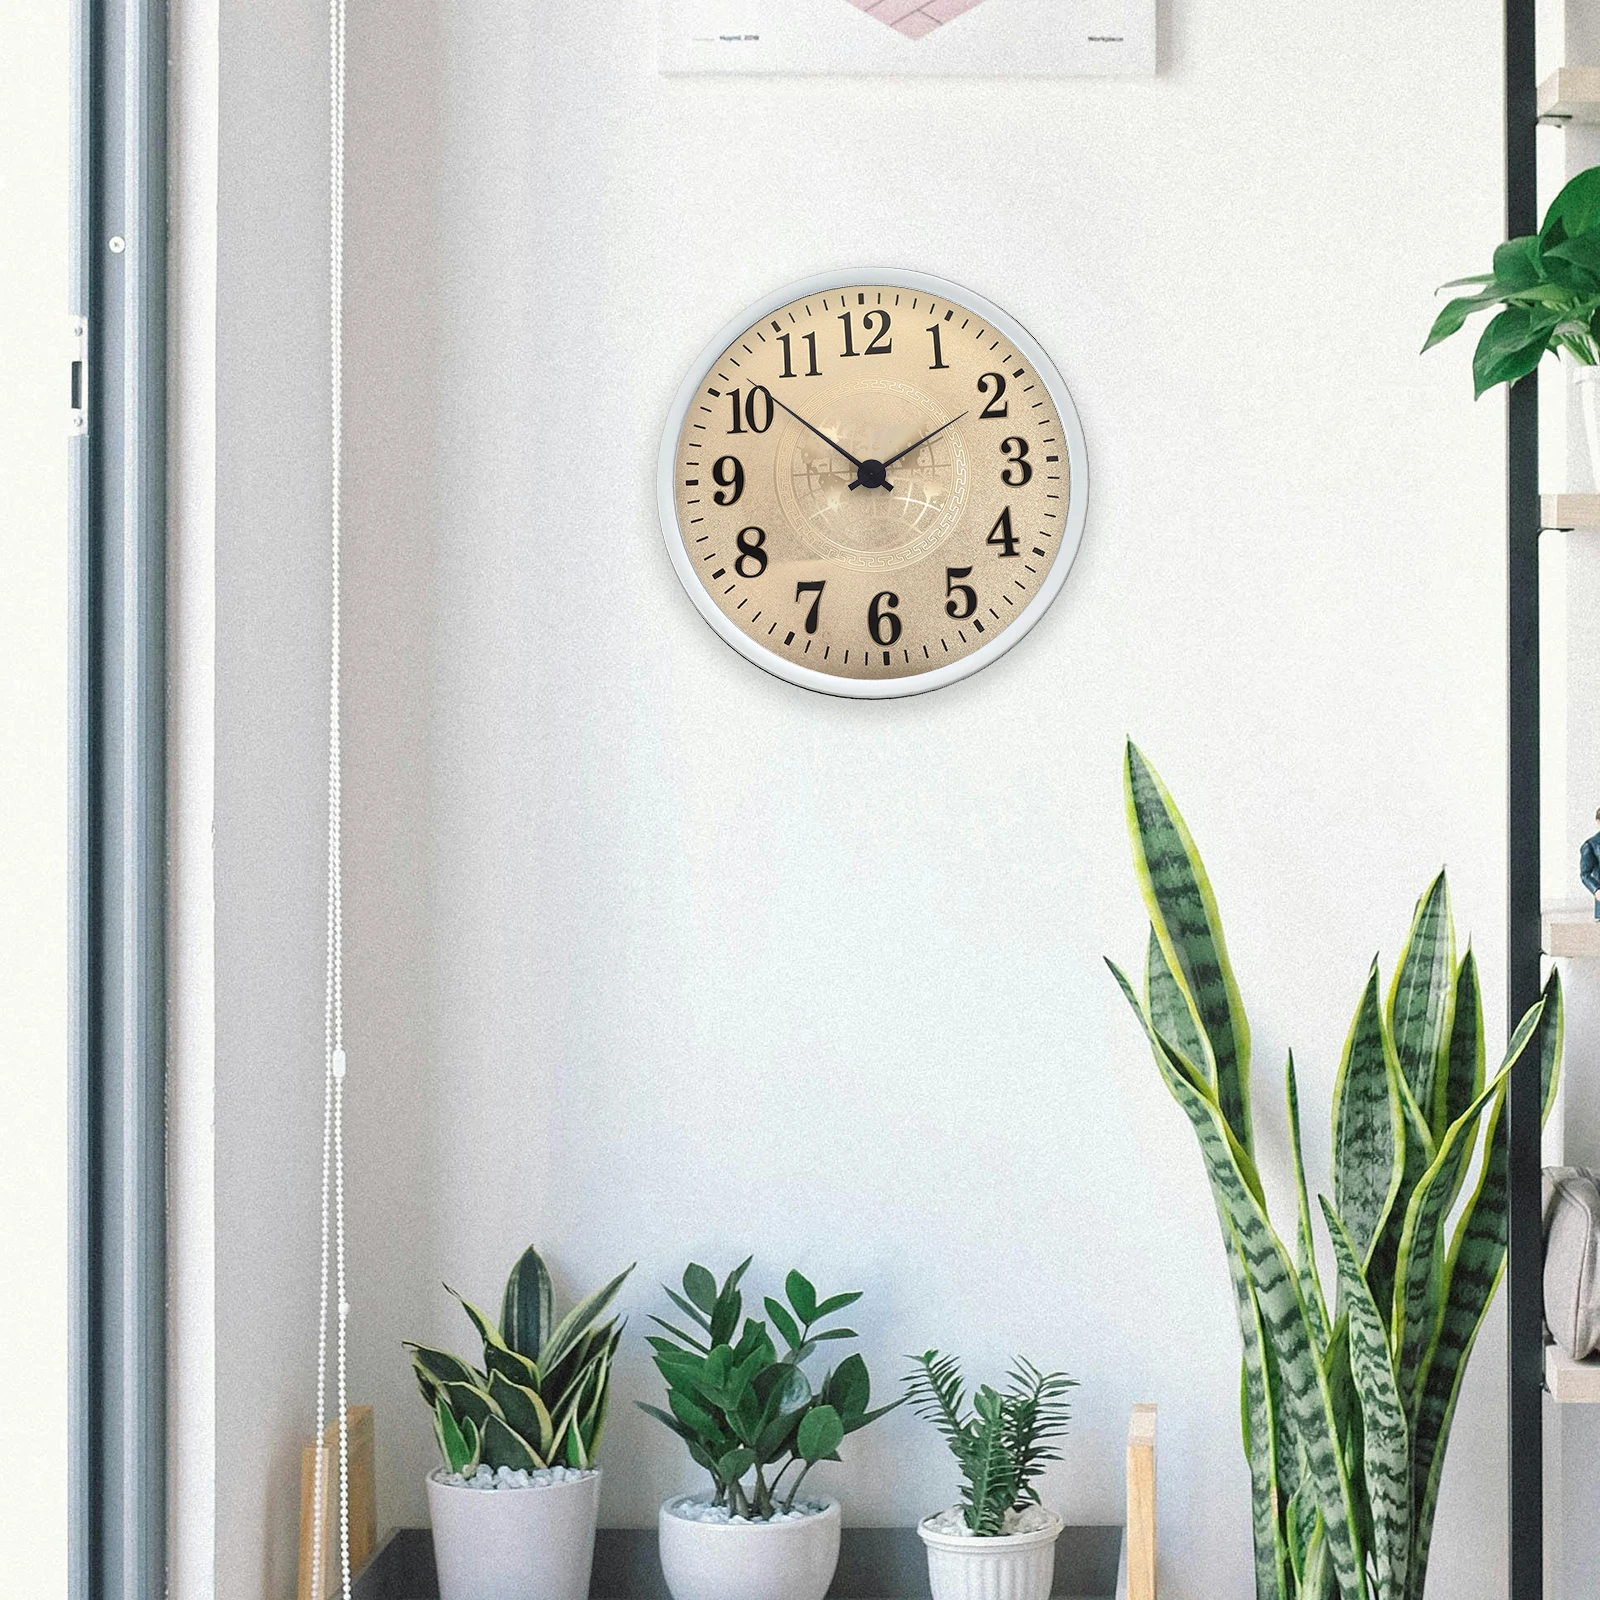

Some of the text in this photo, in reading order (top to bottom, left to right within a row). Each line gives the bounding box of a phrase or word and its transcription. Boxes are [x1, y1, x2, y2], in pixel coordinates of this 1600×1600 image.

[776, 331, 822, 378] 11
[838, 309, 893, 357] 12
[926, 323, 949, 369] 1
[725, 385, 774, 434] 10
[977, 372, 1008, 419] 2
[713, 456, 745, 506] 9
[1001, 437, 1032, 486] 3
[735, 527, 767, 578] 8
[987, 506, 1020, 557] 4
[796, 580, 826, 634] 7
[946, 566, 977, 618] 5
[868, 591, 902, 646] 6
